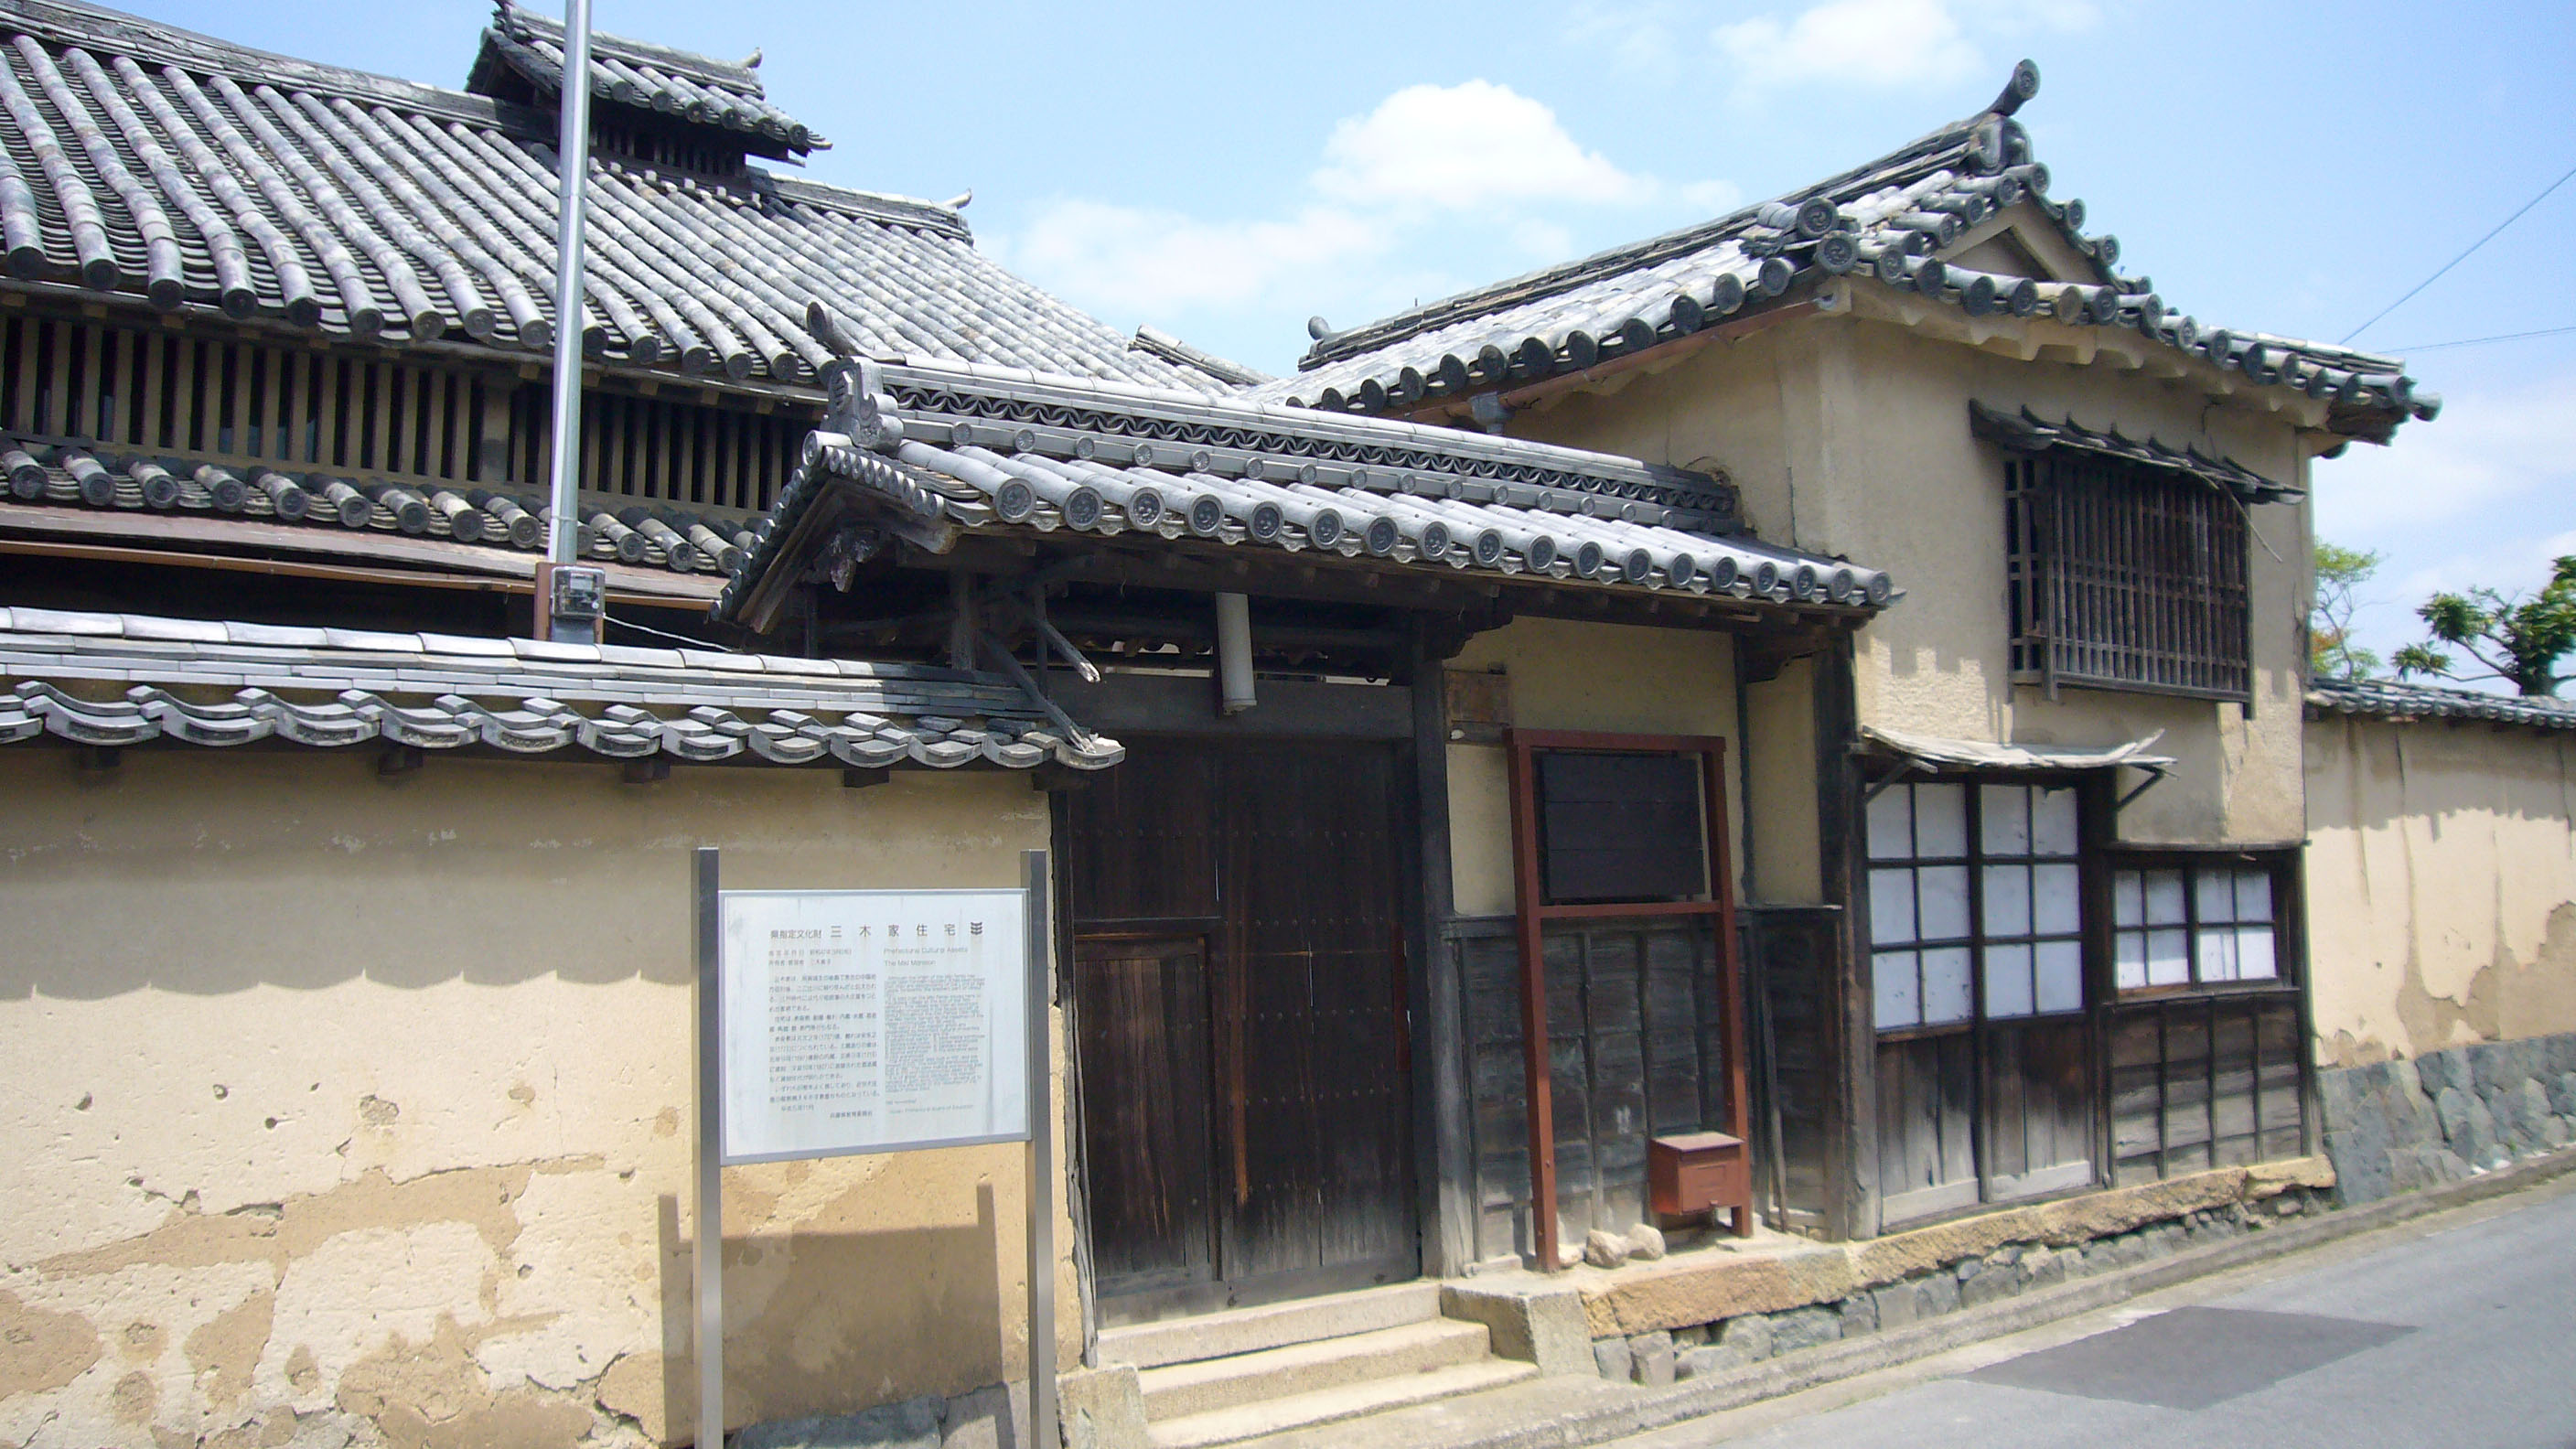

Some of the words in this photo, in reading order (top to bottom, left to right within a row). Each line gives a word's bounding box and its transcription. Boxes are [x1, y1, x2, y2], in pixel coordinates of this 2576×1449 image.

[830, 924, 956, 938] 三木家住宅
